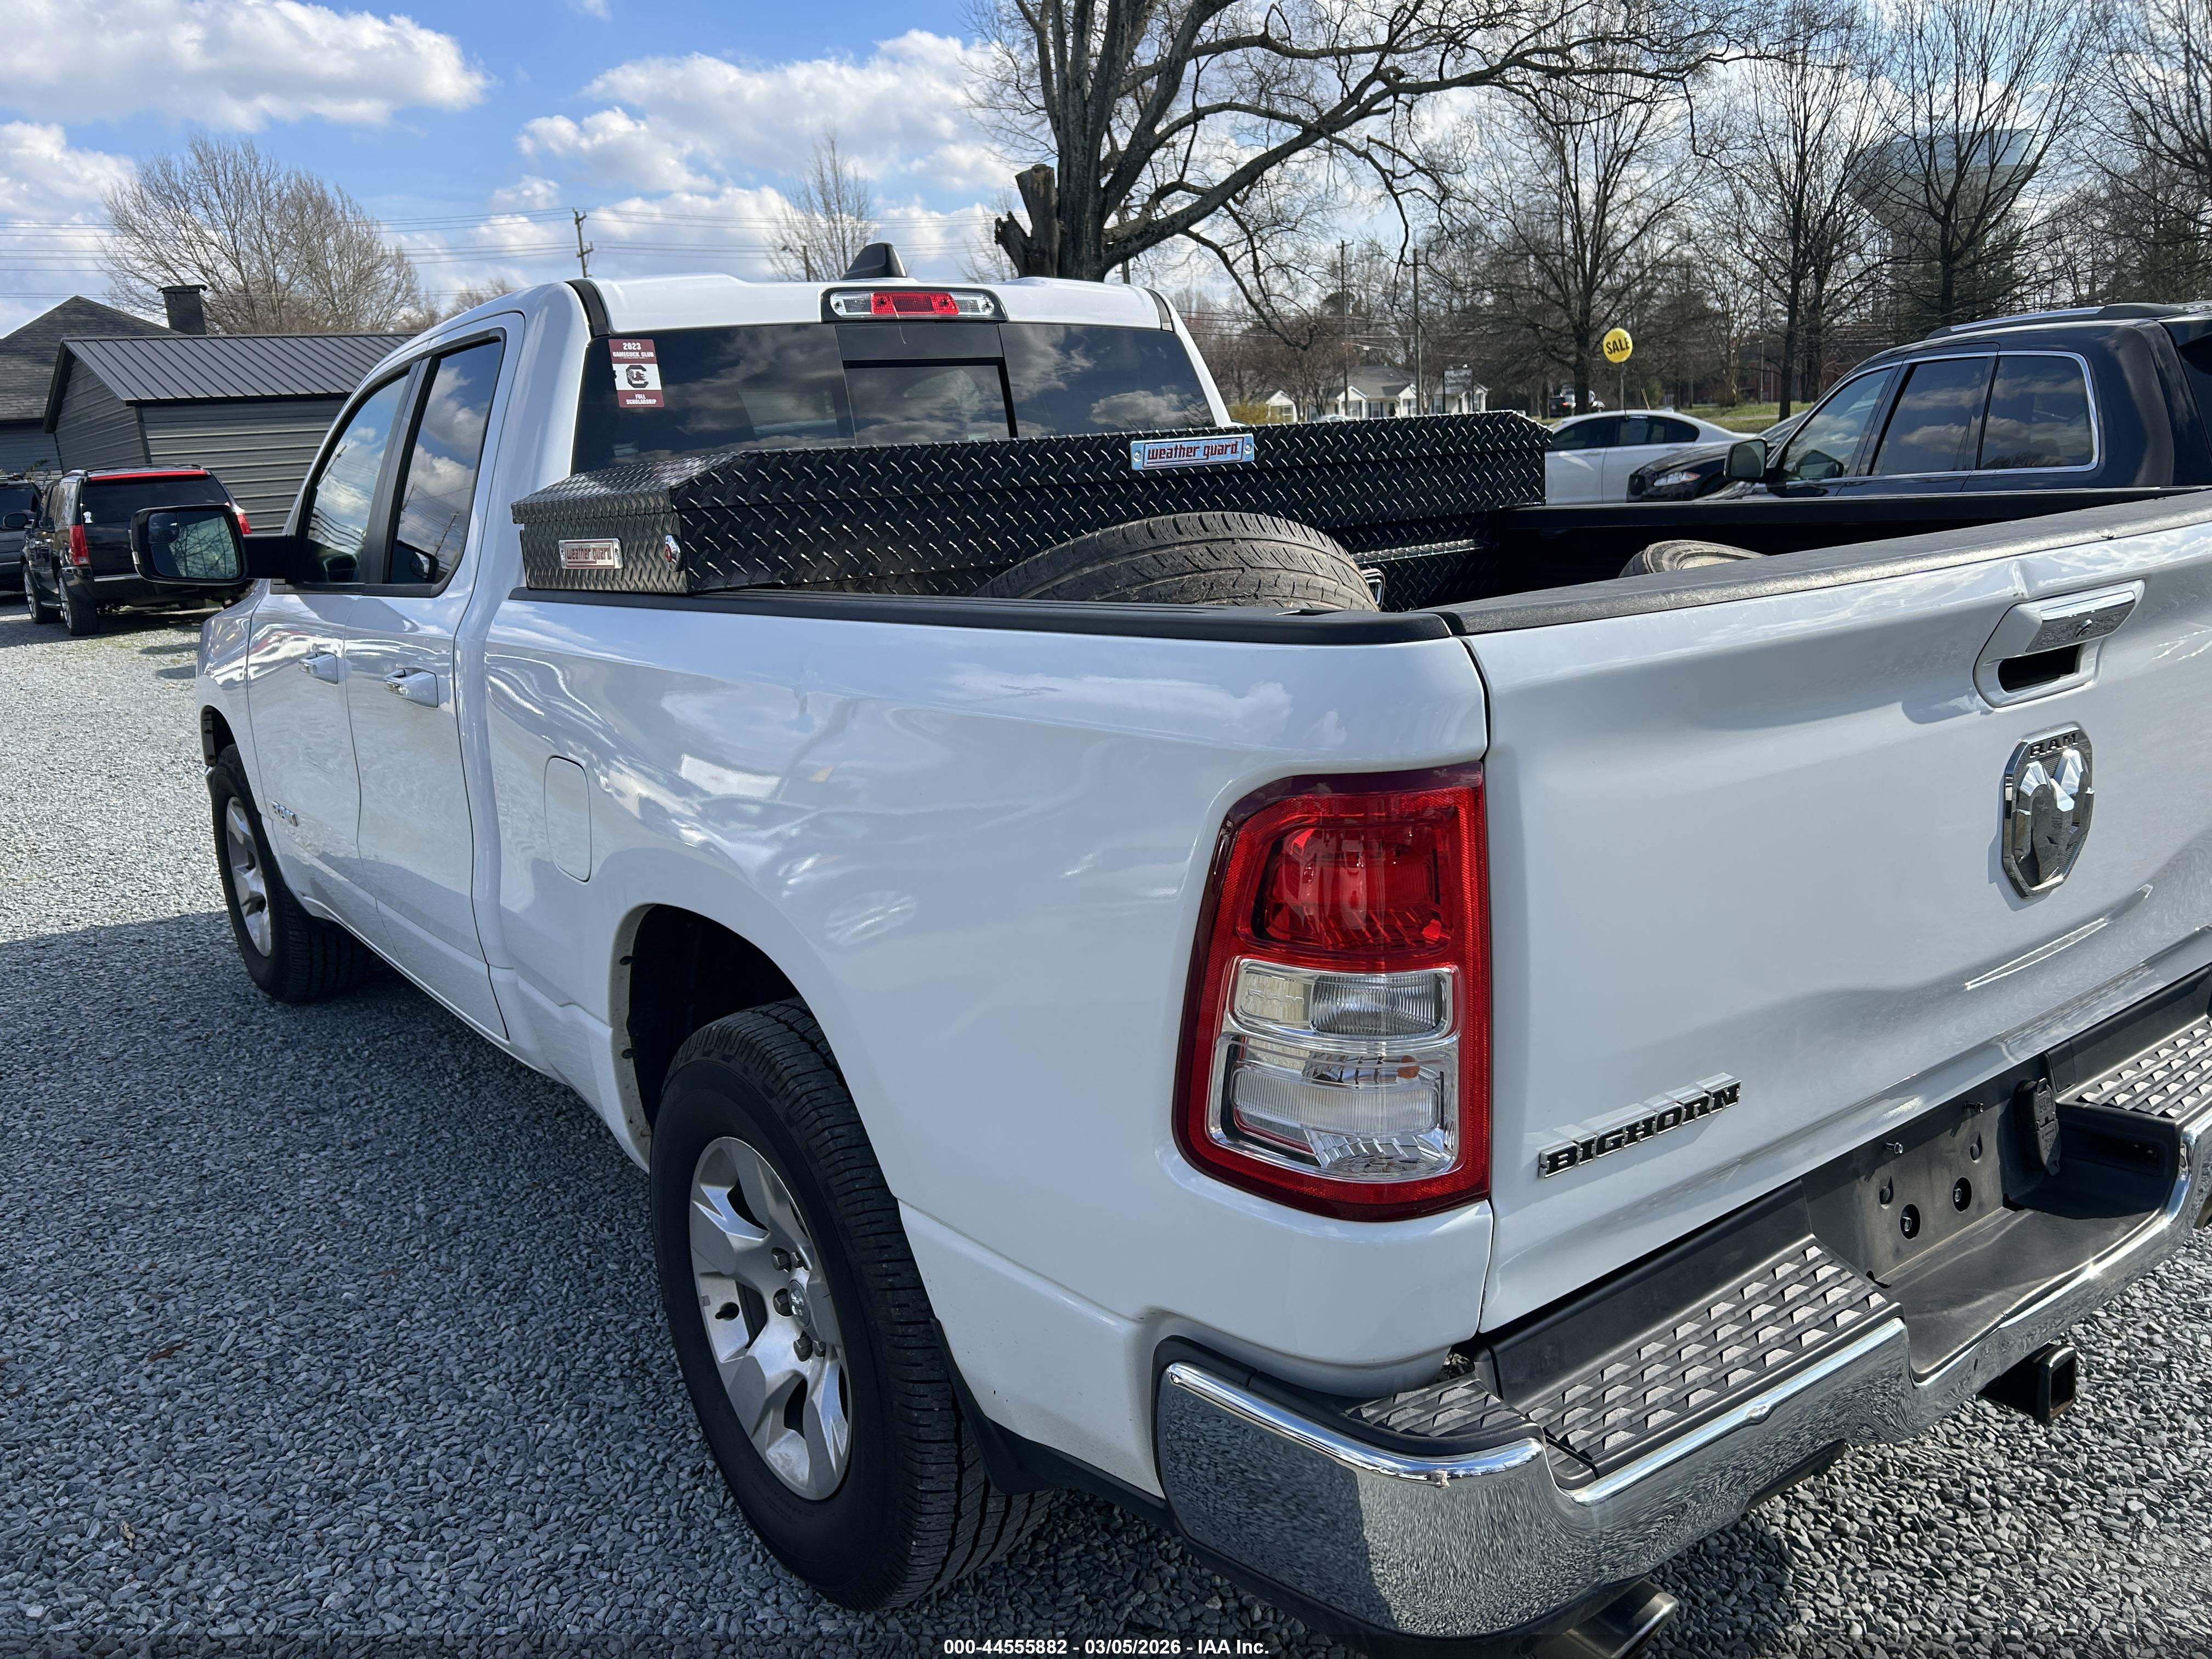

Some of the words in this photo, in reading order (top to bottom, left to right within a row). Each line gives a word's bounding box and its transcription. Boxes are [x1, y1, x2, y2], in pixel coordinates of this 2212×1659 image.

[623, 342, 641, 350] 2023
[1606, 337, 1630, 354] SALE
[1147, 444, 1201, 460] weather
[1203, 441, 1238, 460] guard
[567, 544, 591, 560] weather
[592, 544, 612, 563] guard
[2029, 733, 2079, 759] RAM
[1538, 1079, 1742, 1178] BIGHORN
